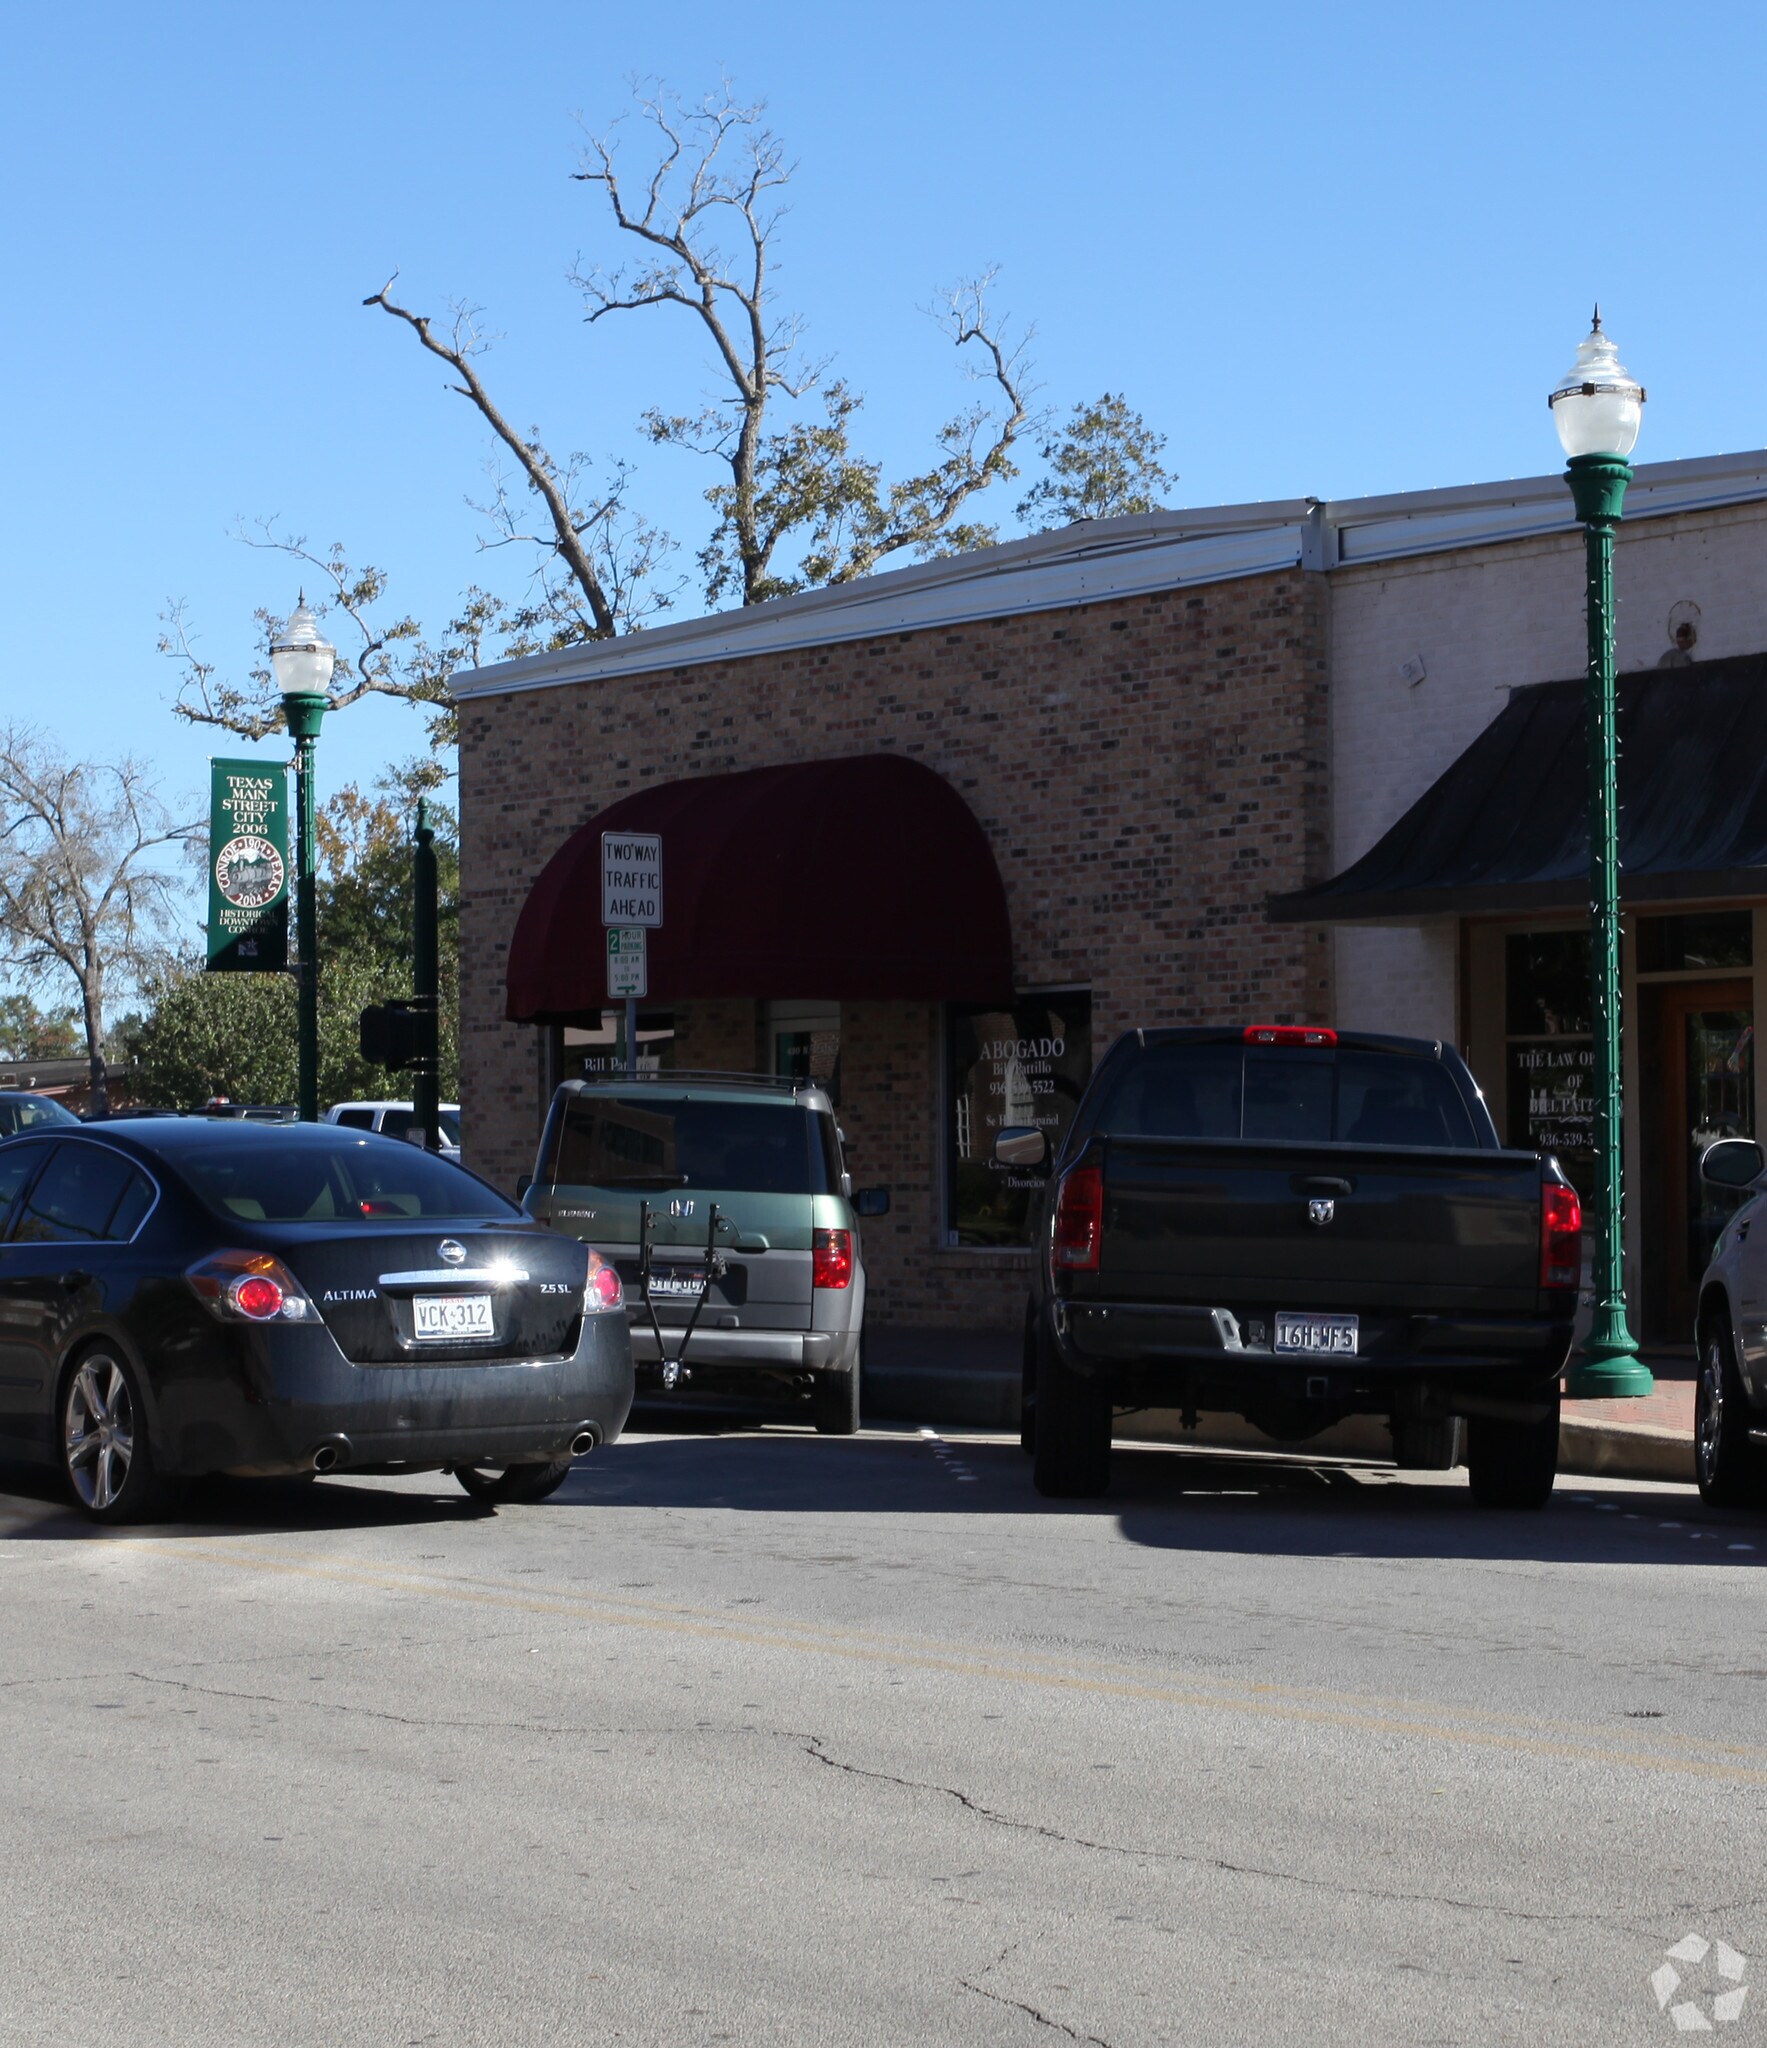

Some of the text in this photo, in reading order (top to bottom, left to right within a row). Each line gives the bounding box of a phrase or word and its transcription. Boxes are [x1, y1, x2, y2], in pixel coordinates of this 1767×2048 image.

[226, 776, 273, 790] TEXAS
[232, 788, 268, 800] MAIN
[222, 799, 278, 812] STREET
[233, 811, 267, 823] CITY
[232, 823, 268, 834] 2006
[243, 838, 267, 854] 1904
[606, 844, 657, 861] TWO WAY
[218, 842, 240, 889] CONROE
[268, 851, 282, 894] TEXAS
[606, 871, 659, 889] TRAFFIC
[236, 894, 263, 906] 2004
[610, 899, 655, 916] AHEAD
[610, 931, 642, 950] 2 HOUR
[980, 1037, 1065, 1060] ABOGADO
[1517, 1051, 1544, 1068] THE
[1547, 1050, 1577, 1068] LAW
[1567, 1074, 1584, 1088] OF
[1008, 1176, 1045, 1188] Divorcios
[323, 1289, 377, 1301] ALTIMA
